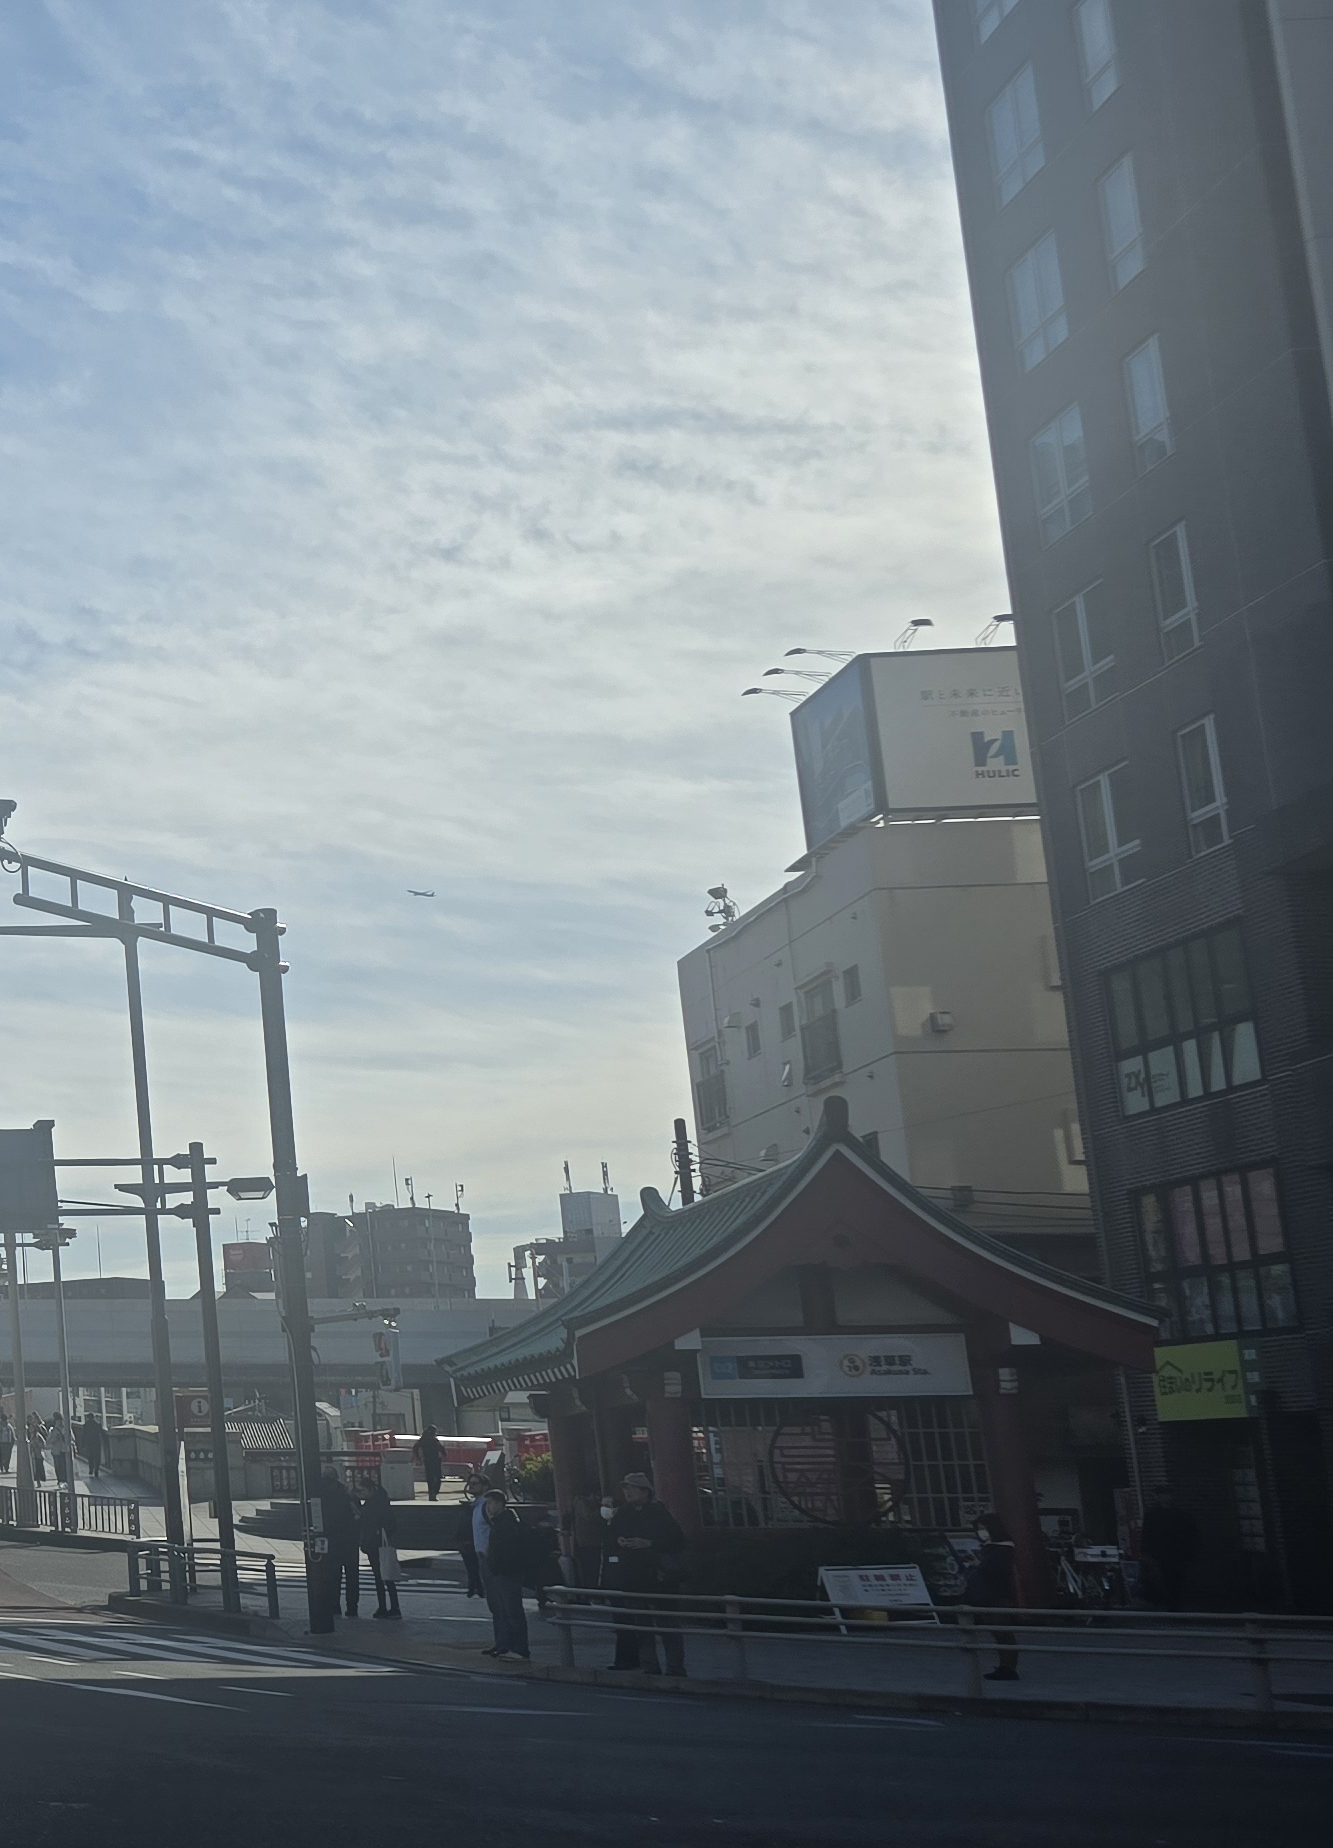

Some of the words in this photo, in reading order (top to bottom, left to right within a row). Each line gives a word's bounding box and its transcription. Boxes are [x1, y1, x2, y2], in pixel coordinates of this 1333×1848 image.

[974, 768, 1021, 779] HULIC
[868, 1355, 913, 1367] 浅草駅
